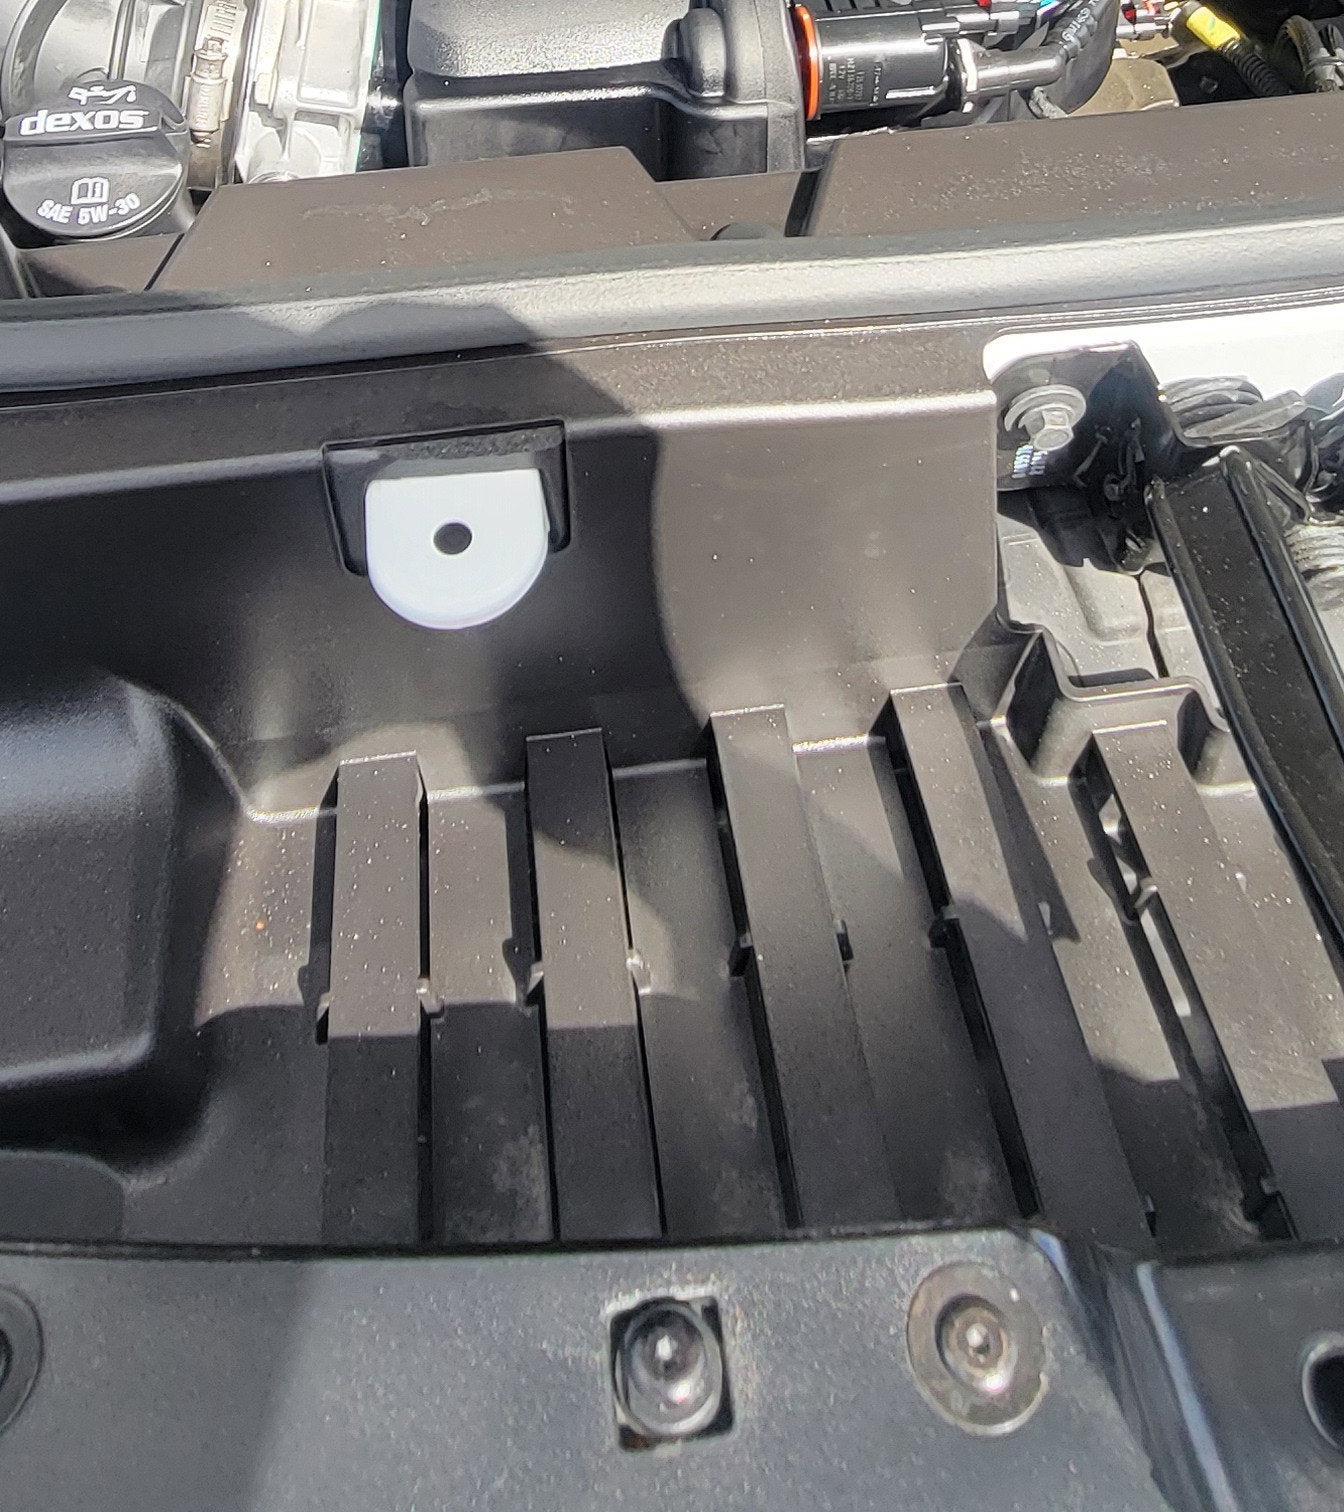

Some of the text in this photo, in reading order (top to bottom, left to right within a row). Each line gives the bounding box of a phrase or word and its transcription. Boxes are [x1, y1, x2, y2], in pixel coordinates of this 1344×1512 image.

[19, 109, 157, 136] dexos
[38, 192, 142, 225] SAE 5W-30
